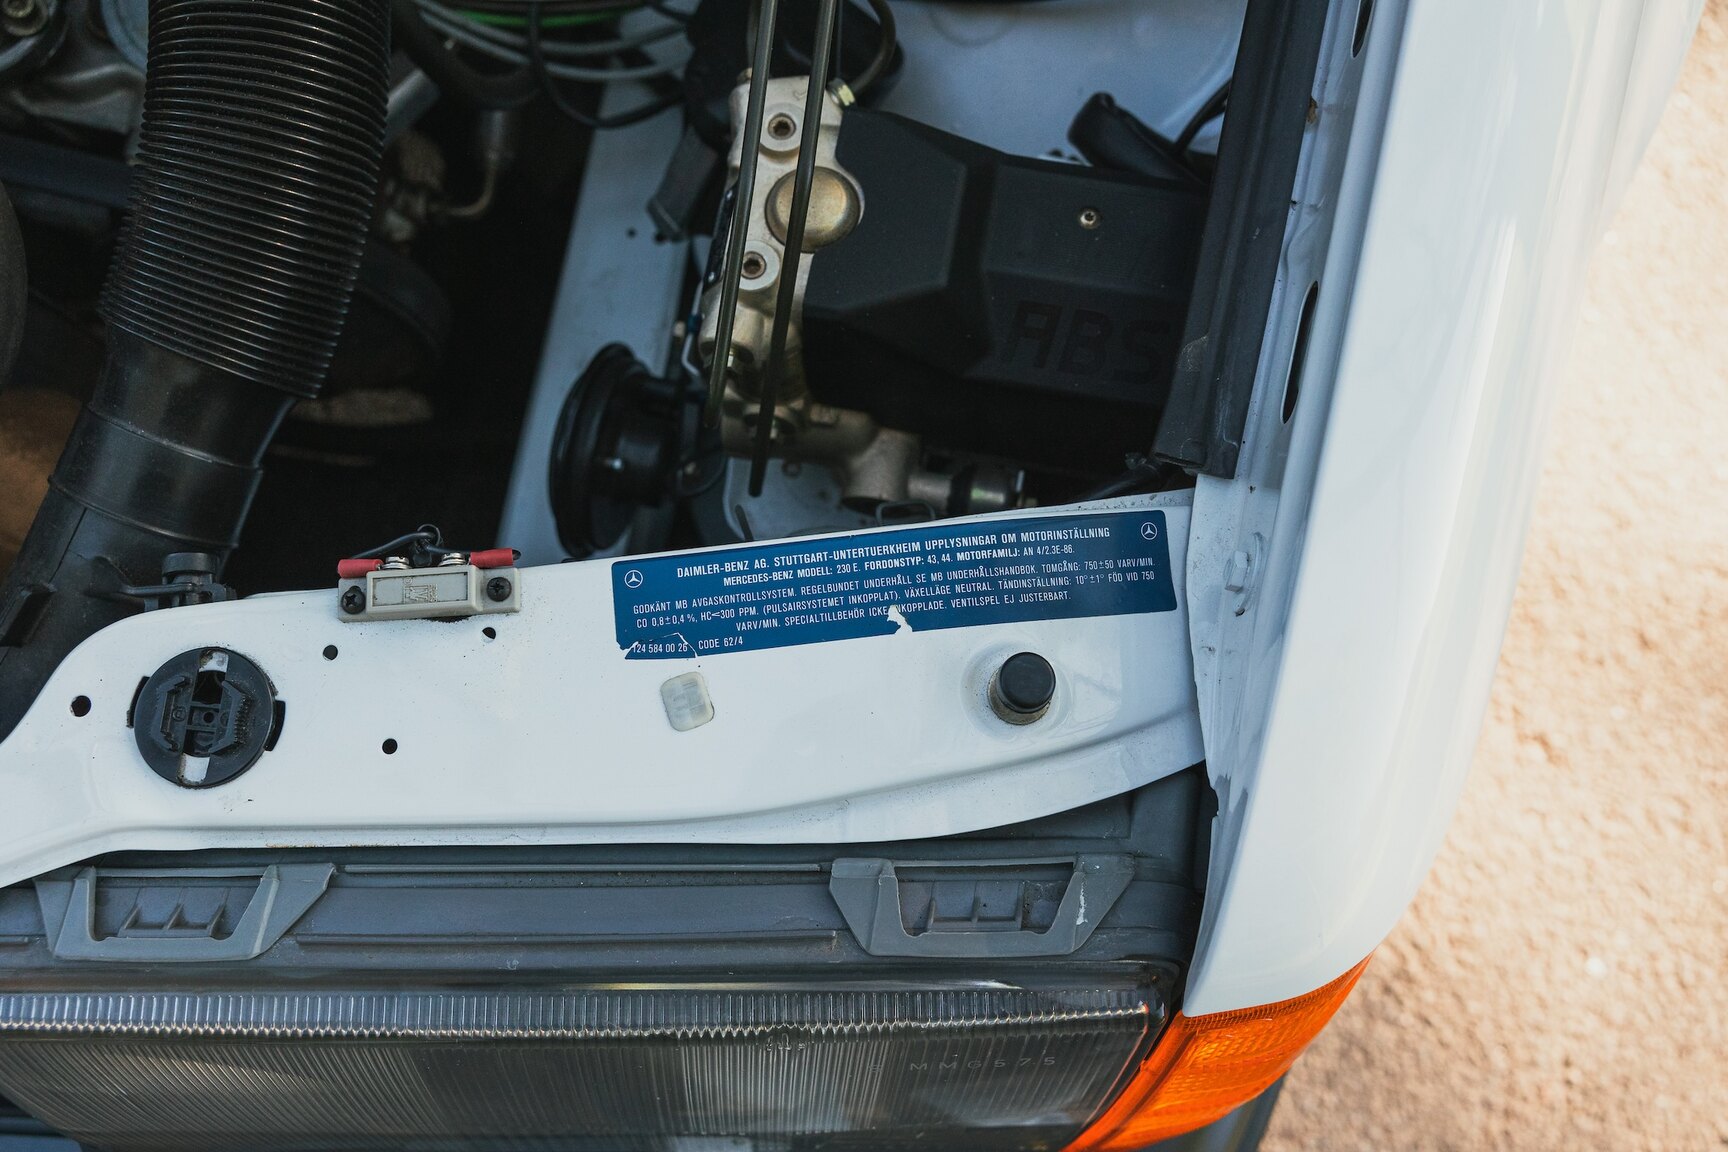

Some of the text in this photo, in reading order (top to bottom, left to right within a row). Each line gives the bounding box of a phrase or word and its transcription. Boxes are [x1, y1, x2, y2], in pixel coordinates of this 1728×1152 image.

[1005, 300, 1174, 385] ABS
[677, 527, 1110, 577] DAIMLER-BENZ AG. STUTTGART-UNTERTUERKHEIM UPPLYSNINGAR OM MOTORINSTÄLLNING
[723, 569, 793, 586] MERCEDES-BENZ
[797, 566, 833, 578] MODELL:
[864, 556, 924, 571] FORDONSTYP:
[956, 547, 1020, 561] MOTORFAMILJ:
[1023, 547, 1034, 556] AN
[633, 557, 1156, 615] GODKÄNT MB AVGASKONTROLLSYSTEM. REGELBUNDET UNDERHÅLL SE MB UNDERHÅLLSHANDBOK. TOMGÅNG: 750±50 VARV/MIN.
[637, 618, 648, 629] CO
[738, 606, 758, 617] PPM.
[904, 584, 951, 599] VÄXELLÄGE
[955, 582, 994, 593] NEUTRAL.
[998, 576, 1072, 590] TÄNDINSTÄLLNING:
[1125, 571, 1139, 582] VID
[1141, 571, 1155, 580] 750
[735, 591, 1071, 631] VARV/MIN. SPECIALTILLBEHÖR ICKE NKOPPLADE. VENTILSPEL EJ JUSTERBART.
[648, 643, 663, 654] 584
[665, 643, 676, 653] 00
[678, 642, 689, 652] 26
[698, 636, 743, 649] CODE 62/4
